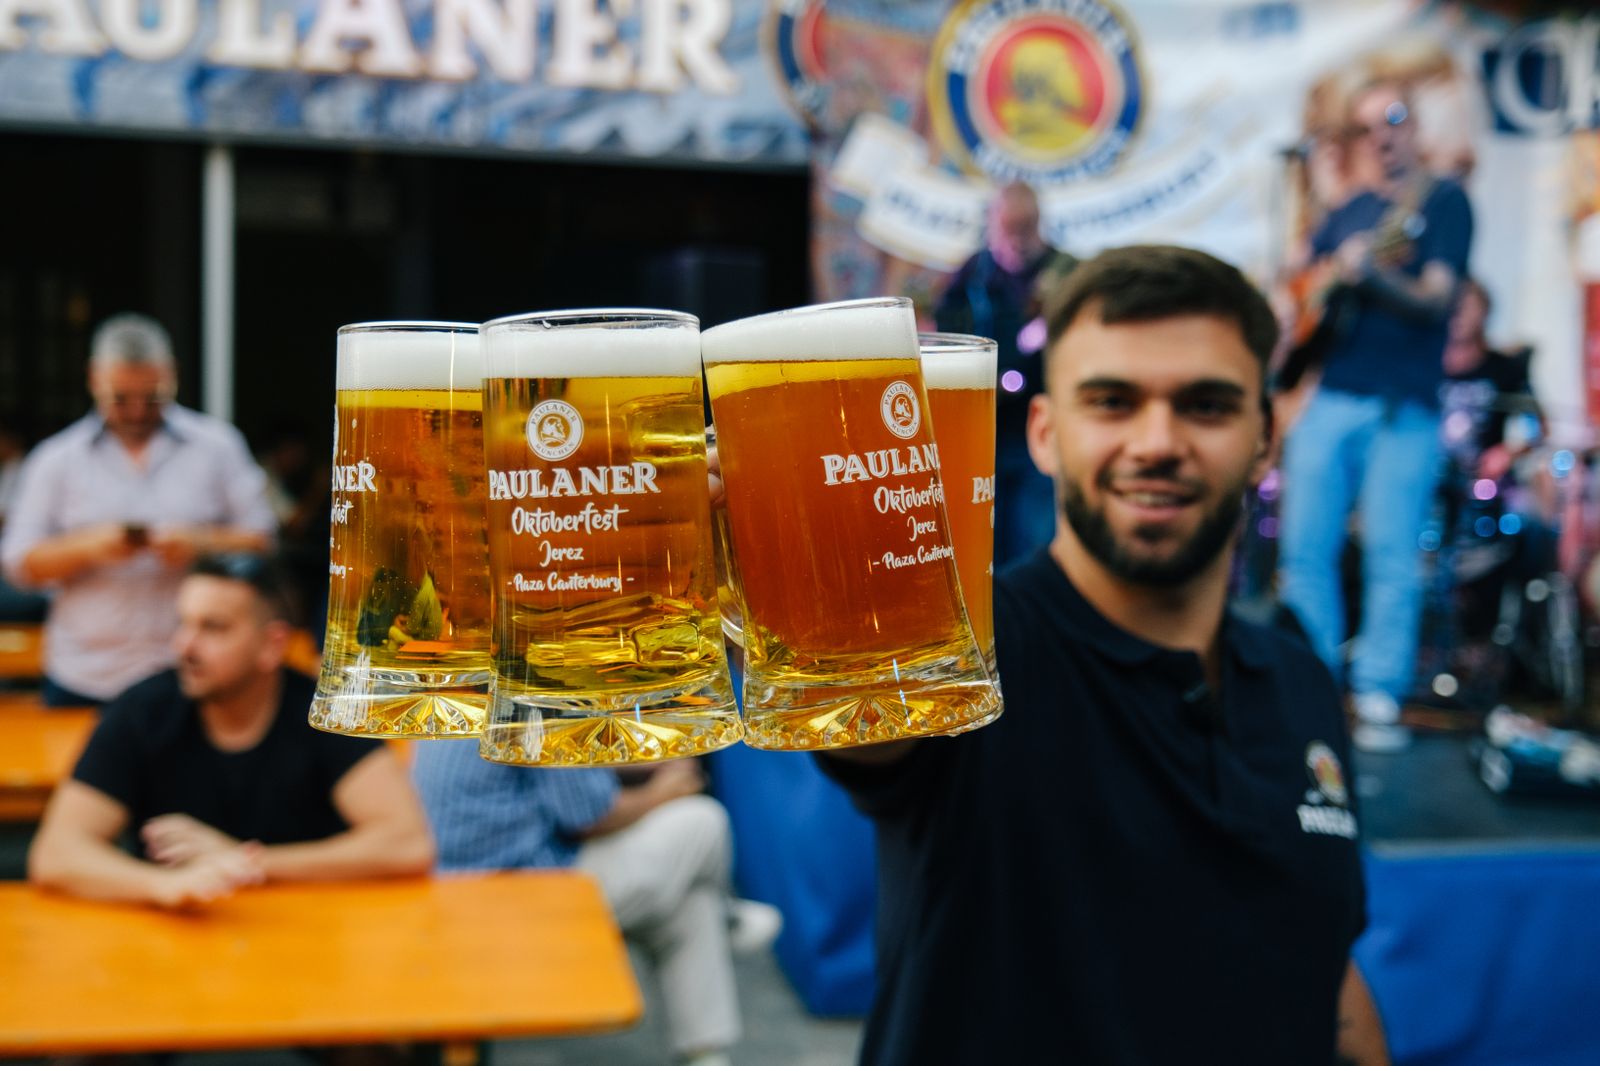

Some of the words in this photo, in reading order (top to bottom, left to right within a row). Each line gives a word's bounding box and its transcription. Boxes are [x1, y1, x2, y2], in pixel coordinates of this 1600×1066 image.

[332, 460, 378, 492] NER
[488, 462, 662, 501] PAULANER
[511, 502, 630, 538] Oktoberfest
[907, 515, 937, 542] Jerez
[538, 540, 585, 568] Jerez
[881, 551, 917, 570] Plaza
[513, 572, 546, 593] Plaza
[546, 571, 622, 593] Canterbury
